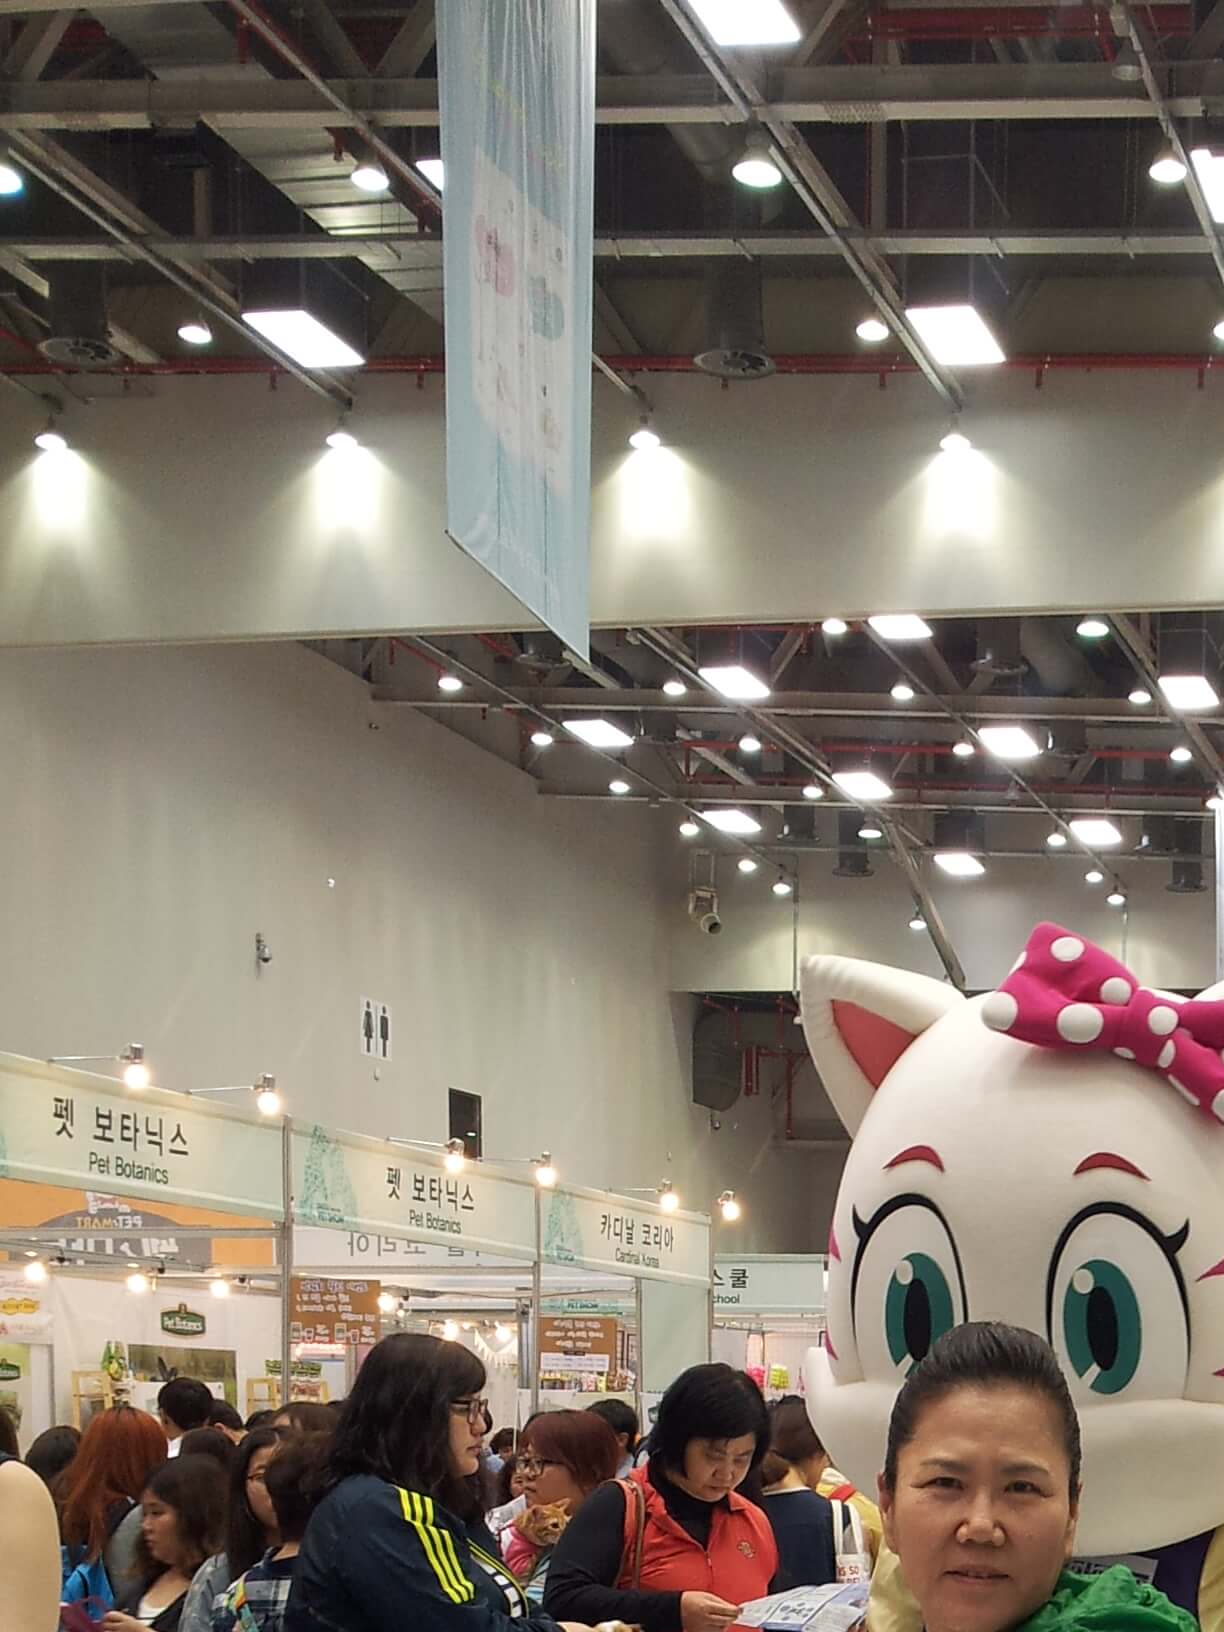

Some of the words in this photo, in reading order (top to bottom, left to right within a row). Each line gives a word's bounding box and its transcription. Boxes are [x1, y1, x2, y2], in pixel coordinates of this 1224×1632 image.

[53, 1097, 74, 1139] 펫
[93, 1106, 189, 1157] 보타닉스
[89, 1152, 111, 1175] Pet
[115, 1156, 169, 1184] Botanics
[386, 1167, 401, 1200] 펫
[412, 1173, 475, 1212] 보타닉스
[409, 1209, 424, 1228] Pet
[426, 1212, 462, 1234] Botanics
[600, 1213, 635, 1245] 카디날
[642, 1223, 675, 1253] 코리아
